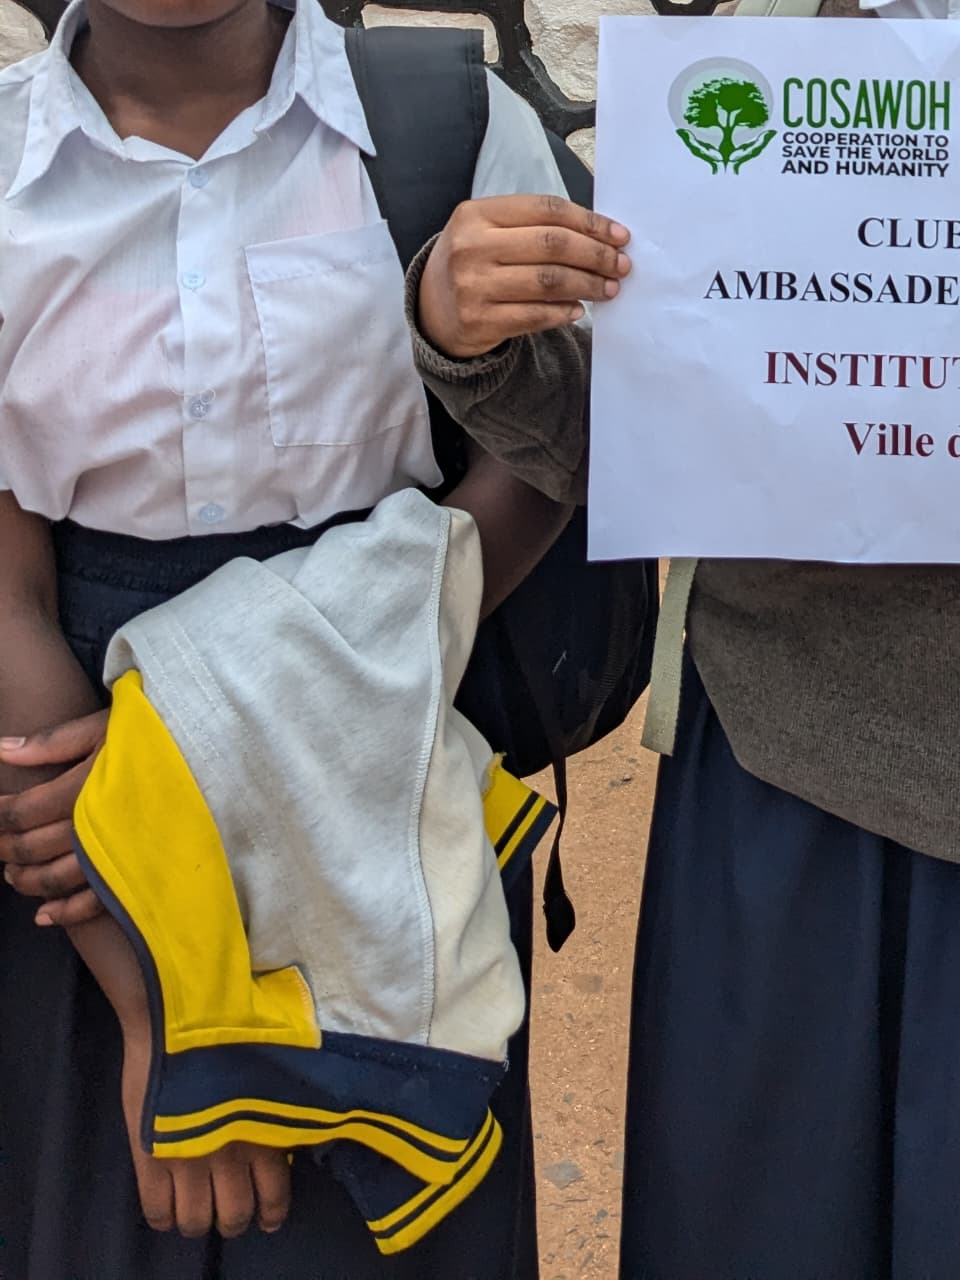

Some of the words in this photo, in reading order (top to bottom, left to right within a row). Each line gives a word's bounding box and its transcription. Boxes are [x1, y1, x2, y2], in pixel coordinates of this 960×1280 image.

[783, 77, 950, 131] COSAWOH
[782, 131, 918, 148] COOPERATION
[924, 134, 949, 148] TO
[782, 145, 831, 158] SAVE
[836, 146, 872, 159] THE
[877, 148, 949, 161] WORLD
[781, 160, 829, 175] AND
[836, 161, 949, 177] HUMANITY
[843, 422, 935, 456] Ville
